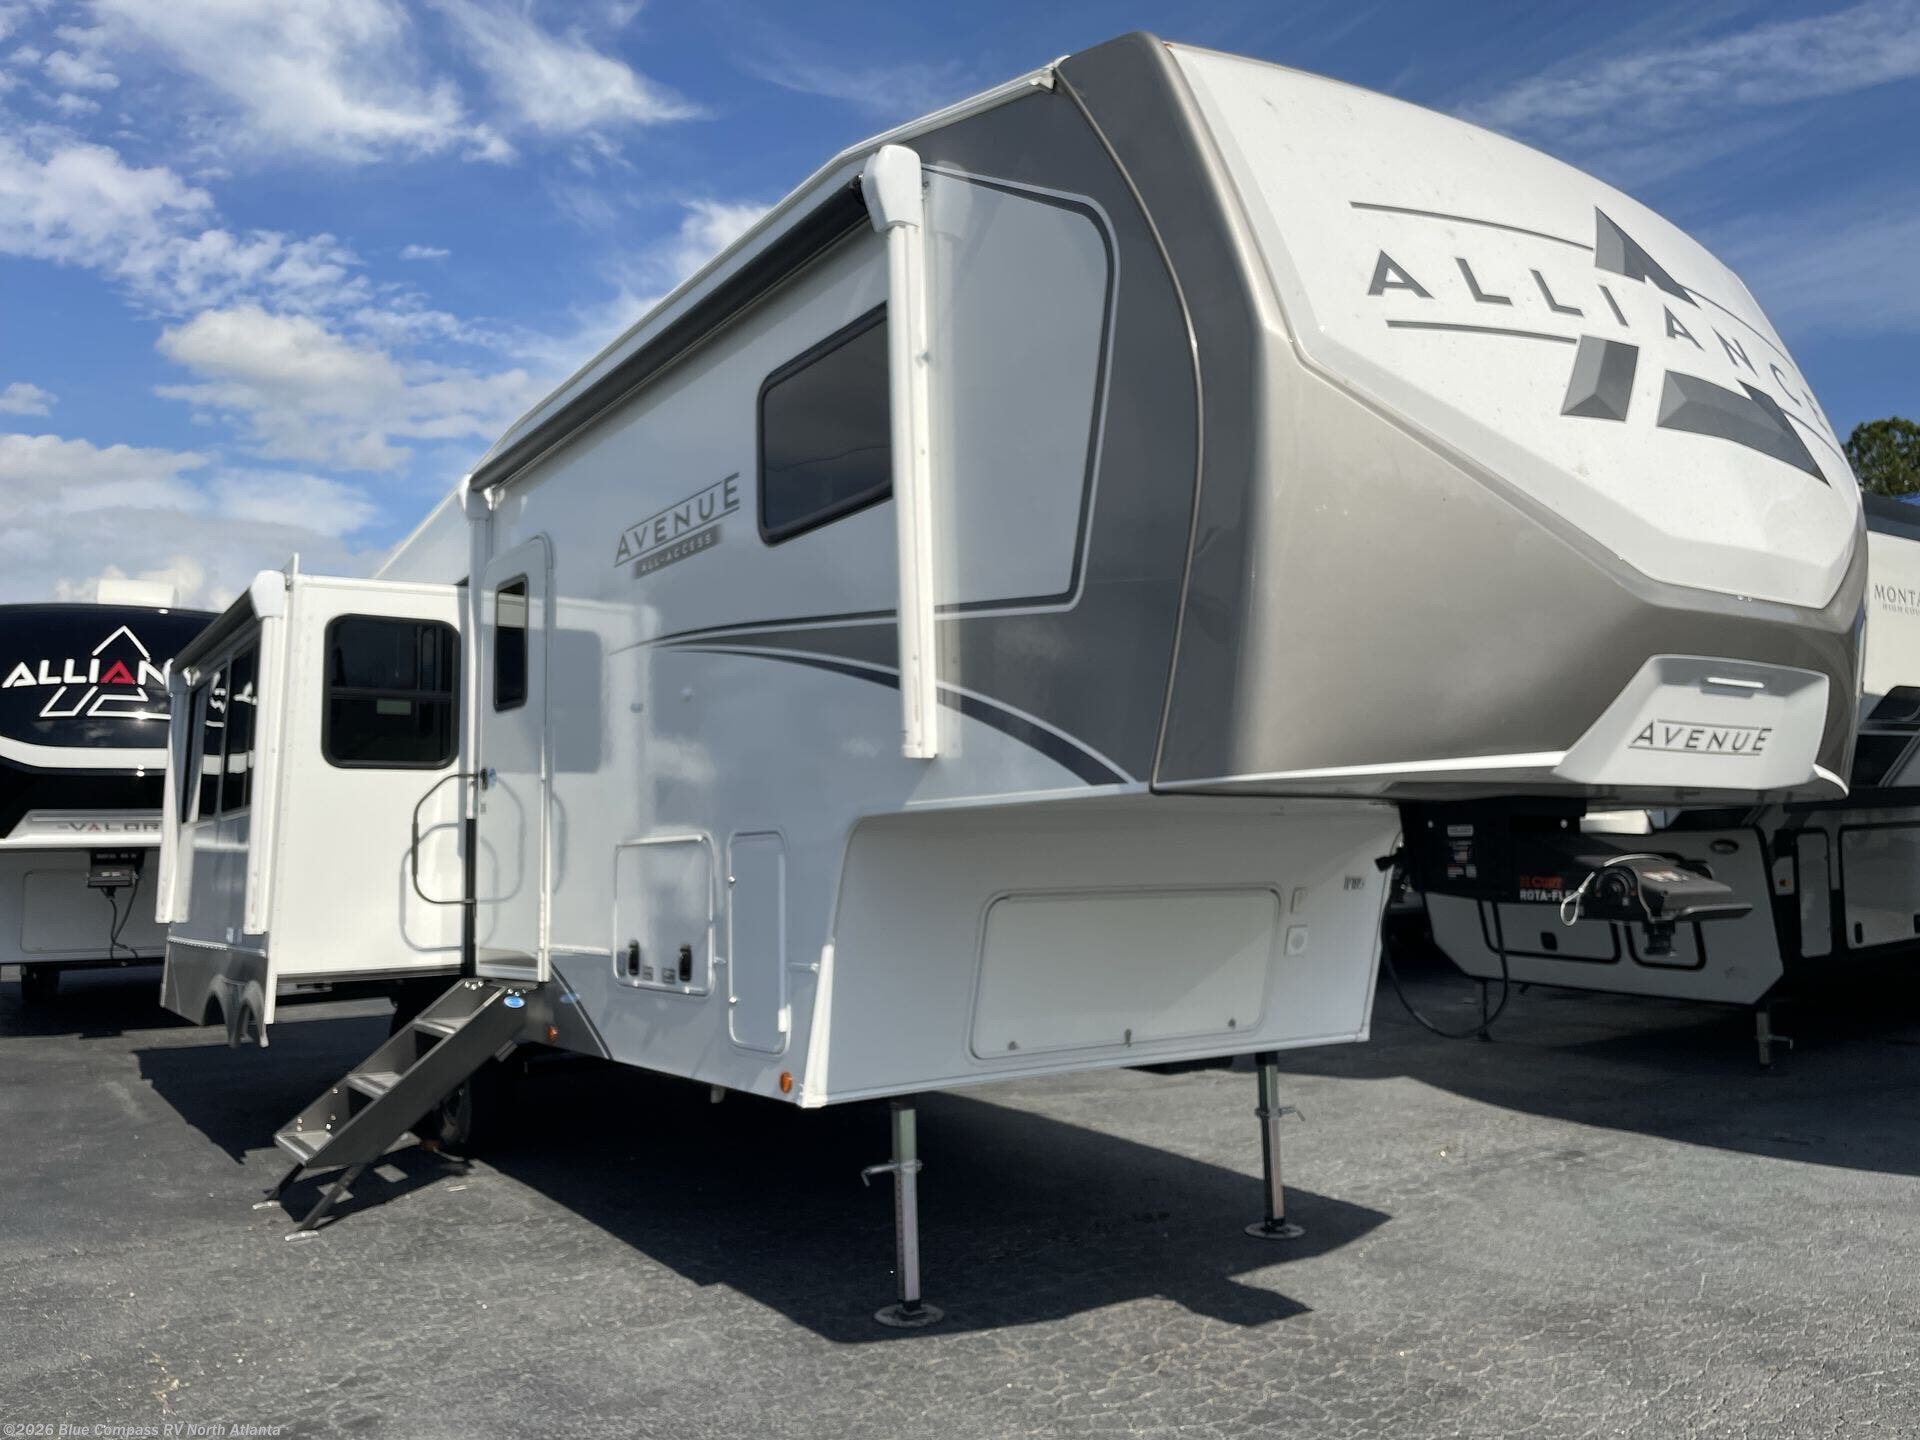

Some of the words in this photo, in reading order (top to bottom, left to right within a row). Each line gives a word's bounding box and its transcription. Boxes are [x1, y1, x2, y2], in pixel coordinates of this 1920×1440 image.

[1366, 249, 1831, 435] ALLIANCE
[615, 472, 740, 564] AVENUE
[1, 658, 165, 689] ALLIAN
[1631, 719, 1773, 752] AVENUE
[69, 822, 160, 832] VALOR
